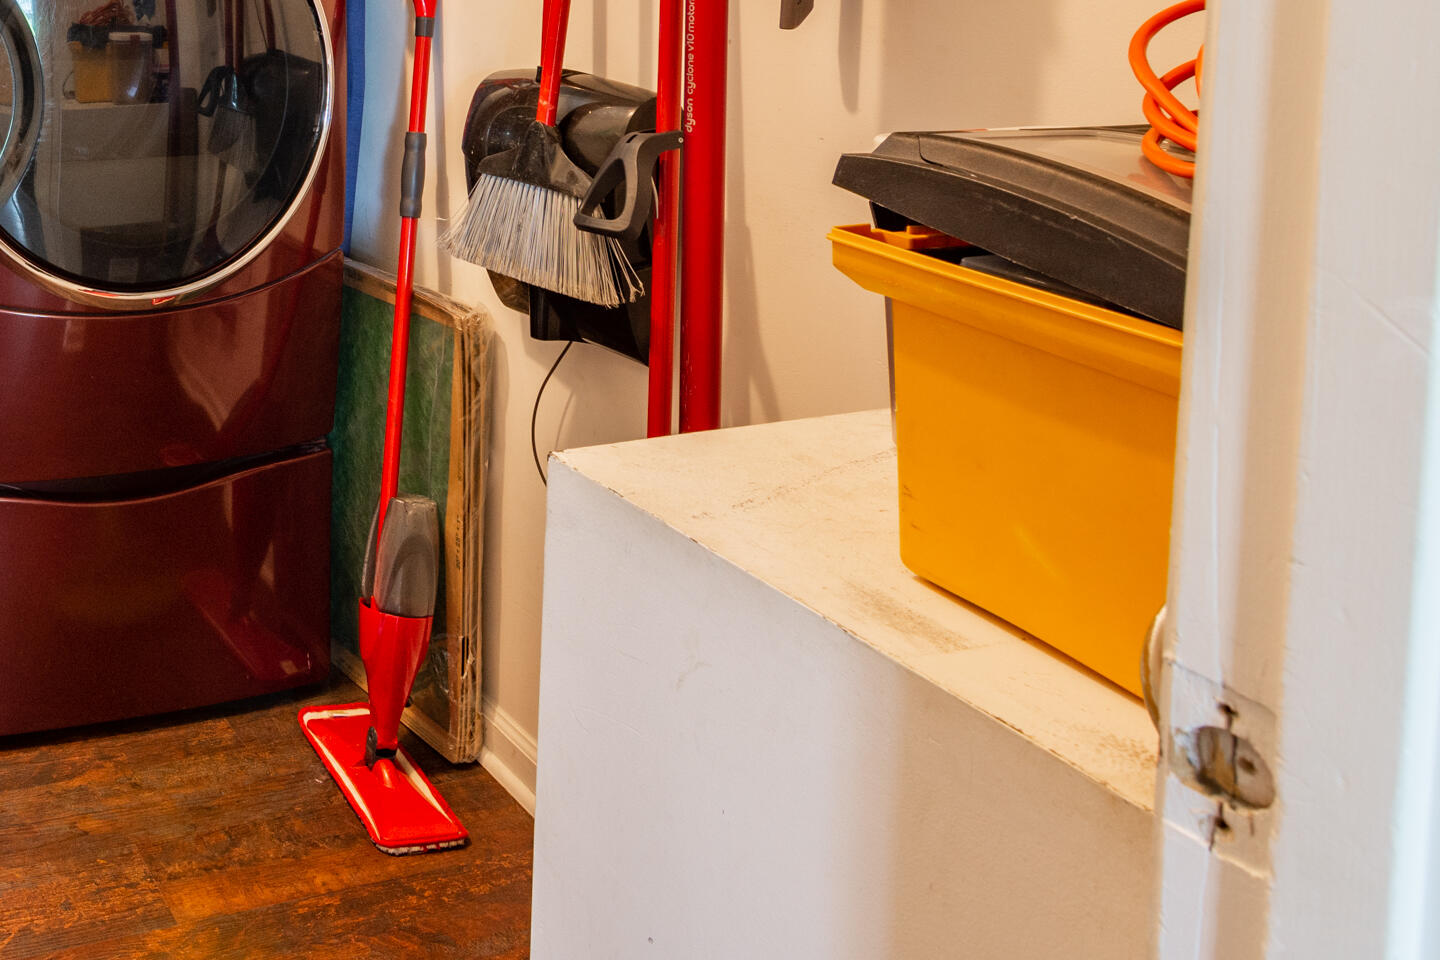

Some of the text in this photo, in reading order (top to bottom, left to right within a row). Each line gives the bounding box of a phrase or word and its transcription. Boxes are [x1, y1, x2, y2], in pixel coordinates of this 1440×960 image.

[686, 33, 696, 51] v10
[687, 53, 697, 95] cyclone
[686, 97, 696, 133] dyson
